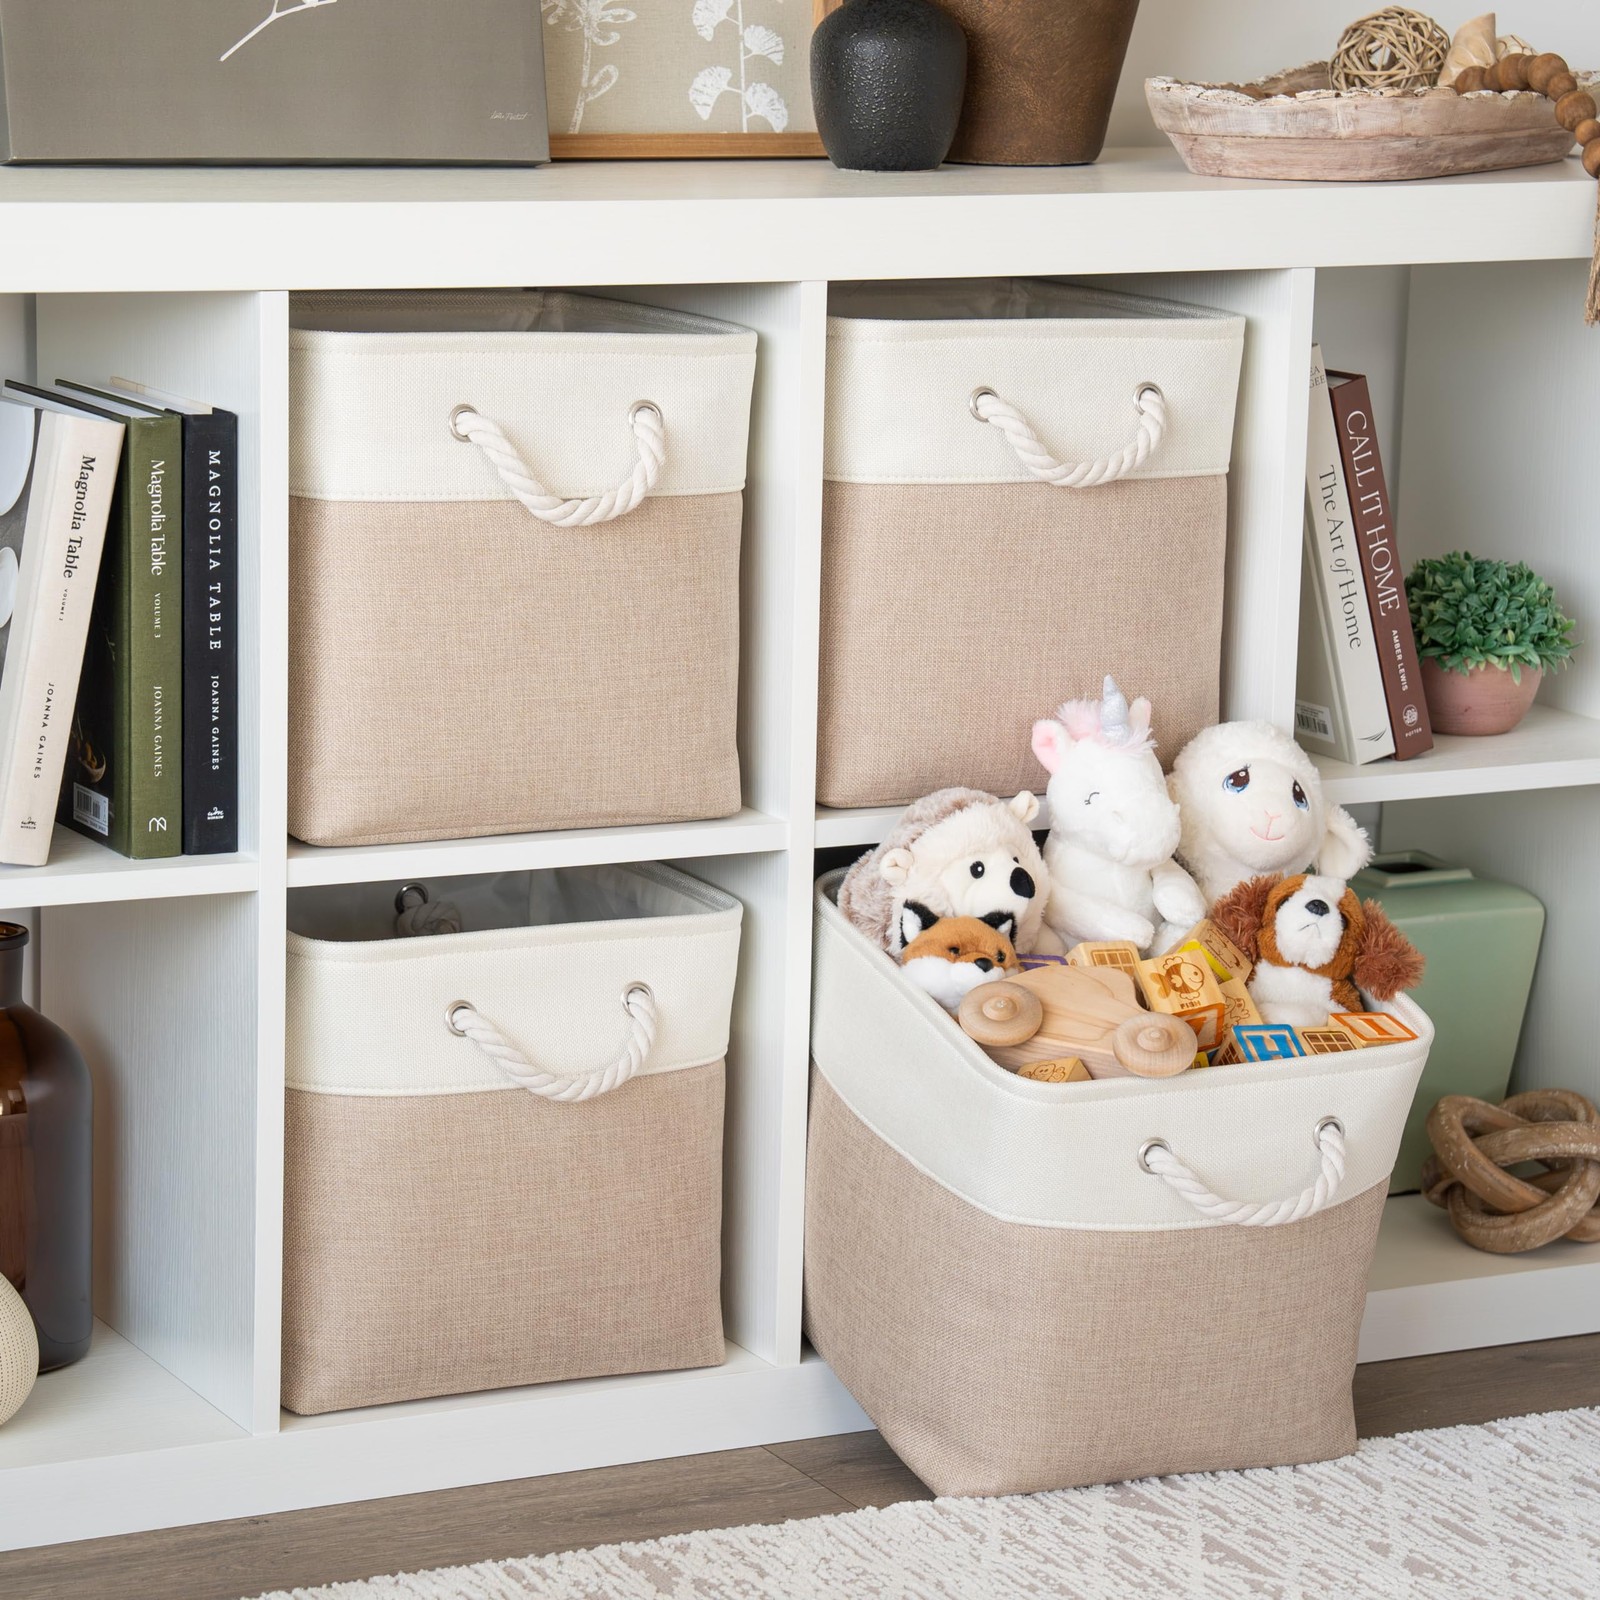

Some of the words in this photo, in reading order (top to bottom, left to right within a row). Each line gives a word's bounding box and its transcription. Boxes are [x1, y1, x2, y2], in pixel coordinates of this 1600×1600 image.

[1346, 410, 1375, 488] CALL
[71, 454, 97, 531] Magnolia
[147, 459, 166, 532] Magnolia
[208, 450, 221, 570] MAGNOLIA
[1319, 464, 1338, 513] The
[1360, 490, 1383, 517] IT
[63, 536, 84, 579] Table
[151, 533, 167, 576] Table
[1327, 517, 1345, 554] Art
[1330, 558, 1354, 579] of
[1366, 524, 1400, 617] HOME
[209, 582, 222, 650] TABLE
[1339, 579, 1362, 650] Home
[1391, 629, 1403, 661] AMBER
[1398, 662, 1409, 692] LEWIS
[41, 682, 55, 728] JOANNA
[153, 686, 163, 731] JOANNA
[210, 675, 220, 722] JOANNA
[33, 735, 47, 779] GAINES
[154, 735, 163, 778] GAINES
[211, 727, 220, 771] GAINES
[1246, 1033, 1295, 1062] H
